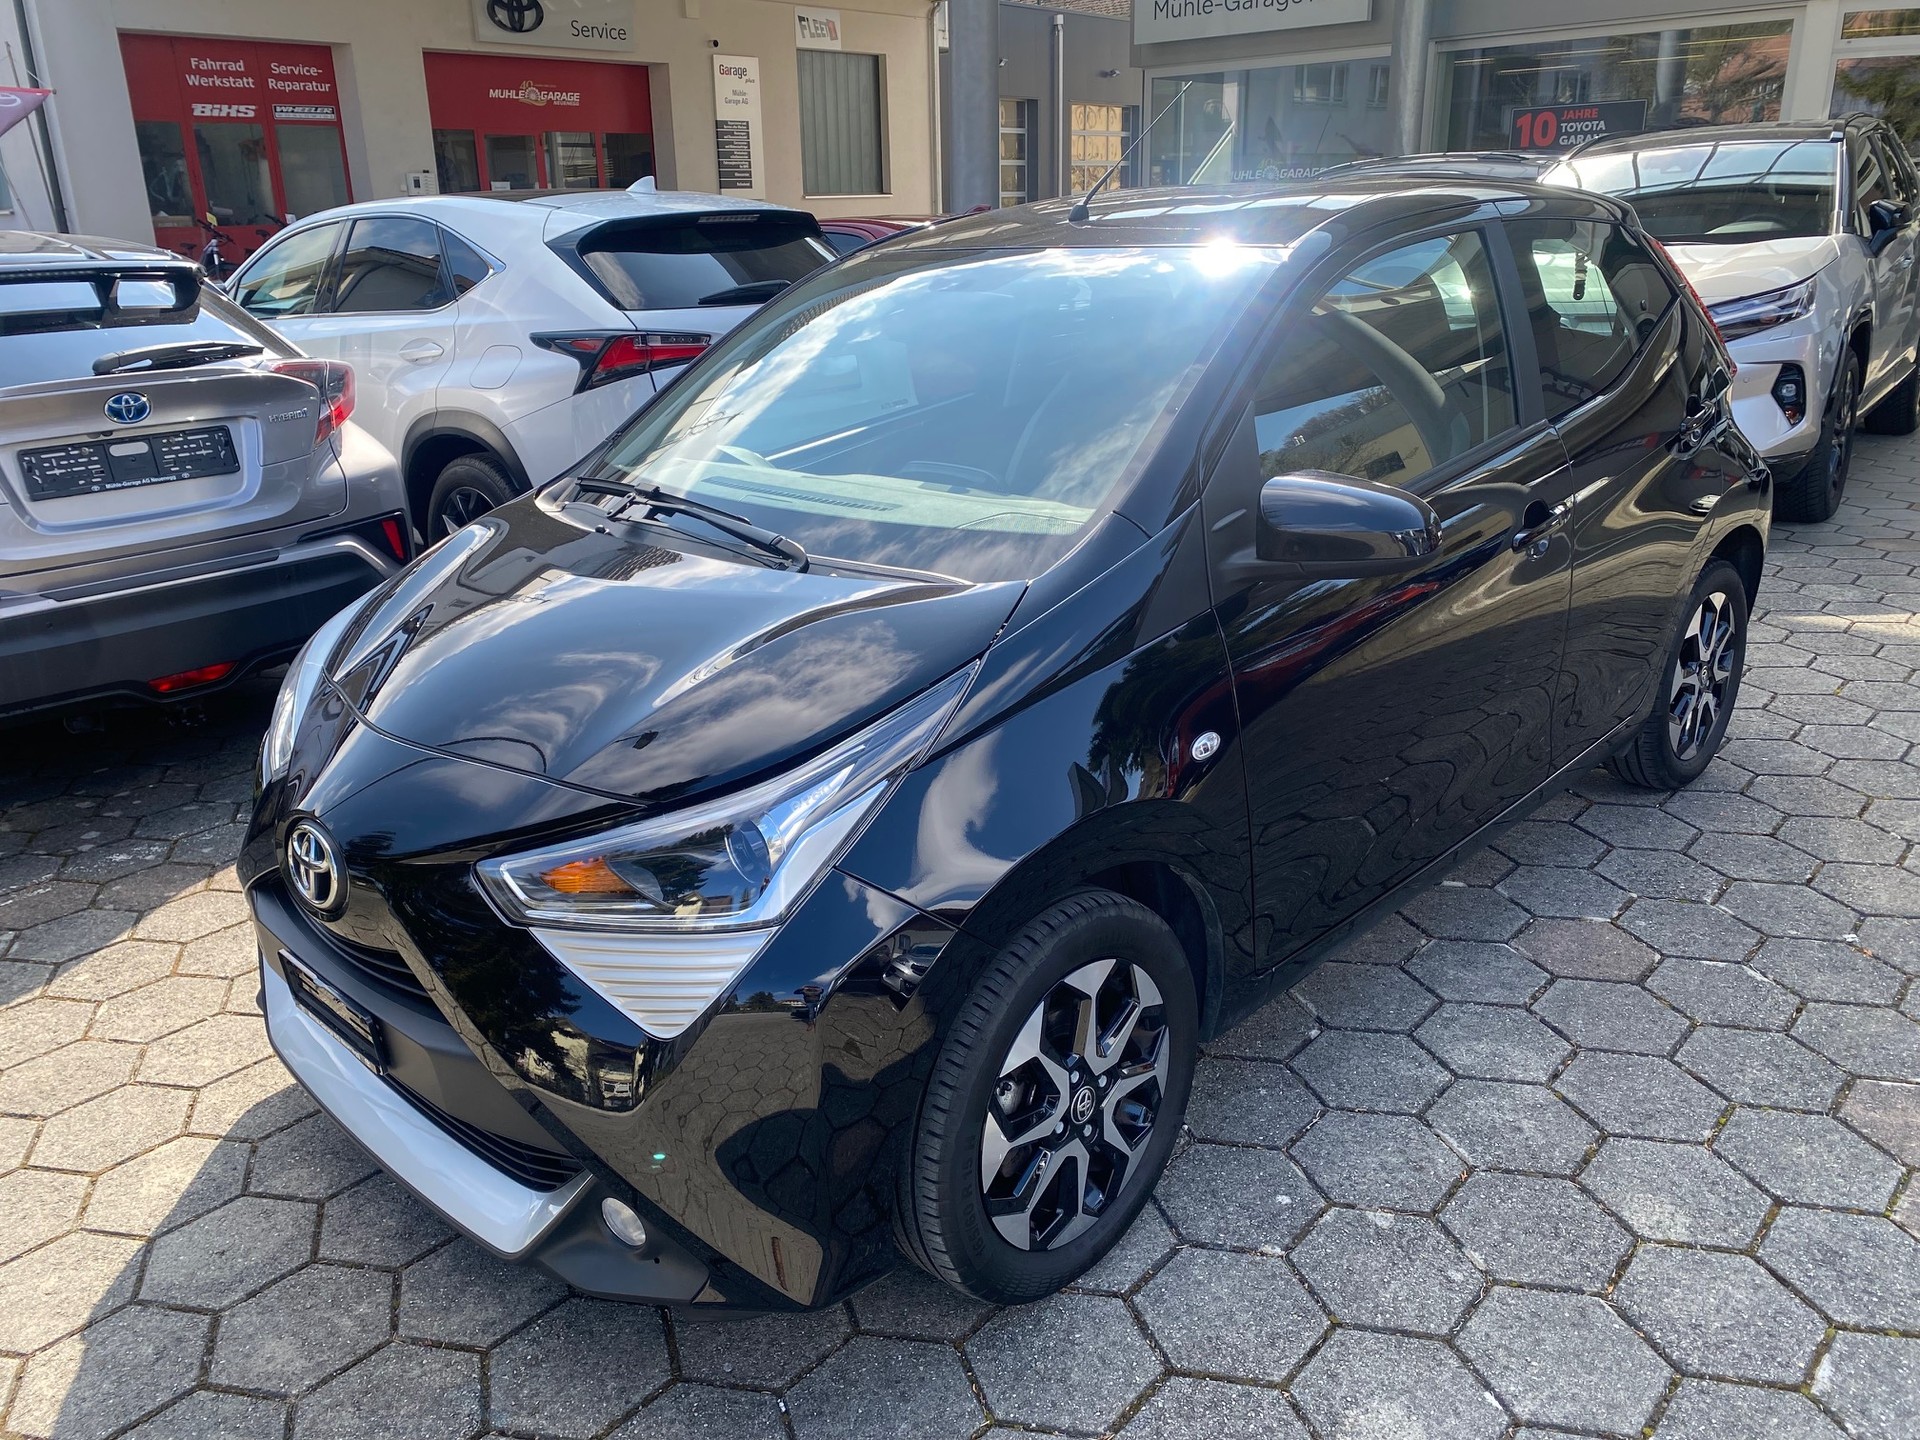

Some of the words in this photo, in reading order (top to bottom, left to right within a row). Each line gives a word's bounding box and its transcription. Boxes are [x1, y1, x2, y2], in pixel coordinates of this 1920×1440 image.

[571, 19, 627, 41] Service
[190, 57, 245, 71] Fahrrad
[270, 62, 323, 76] Service-
[718, 63, 747, 79] Garage
[185, 73, 255, 88] Werkstatt
[267, 77, 331, 92] Reparatur
[541, 91, 580, 102] GARAGE
[1561, 108, 1599, 120] JAHRE
[1516, 111, 1557, 148] 10
[1560, 120, 1606, 133] TOYOTA
